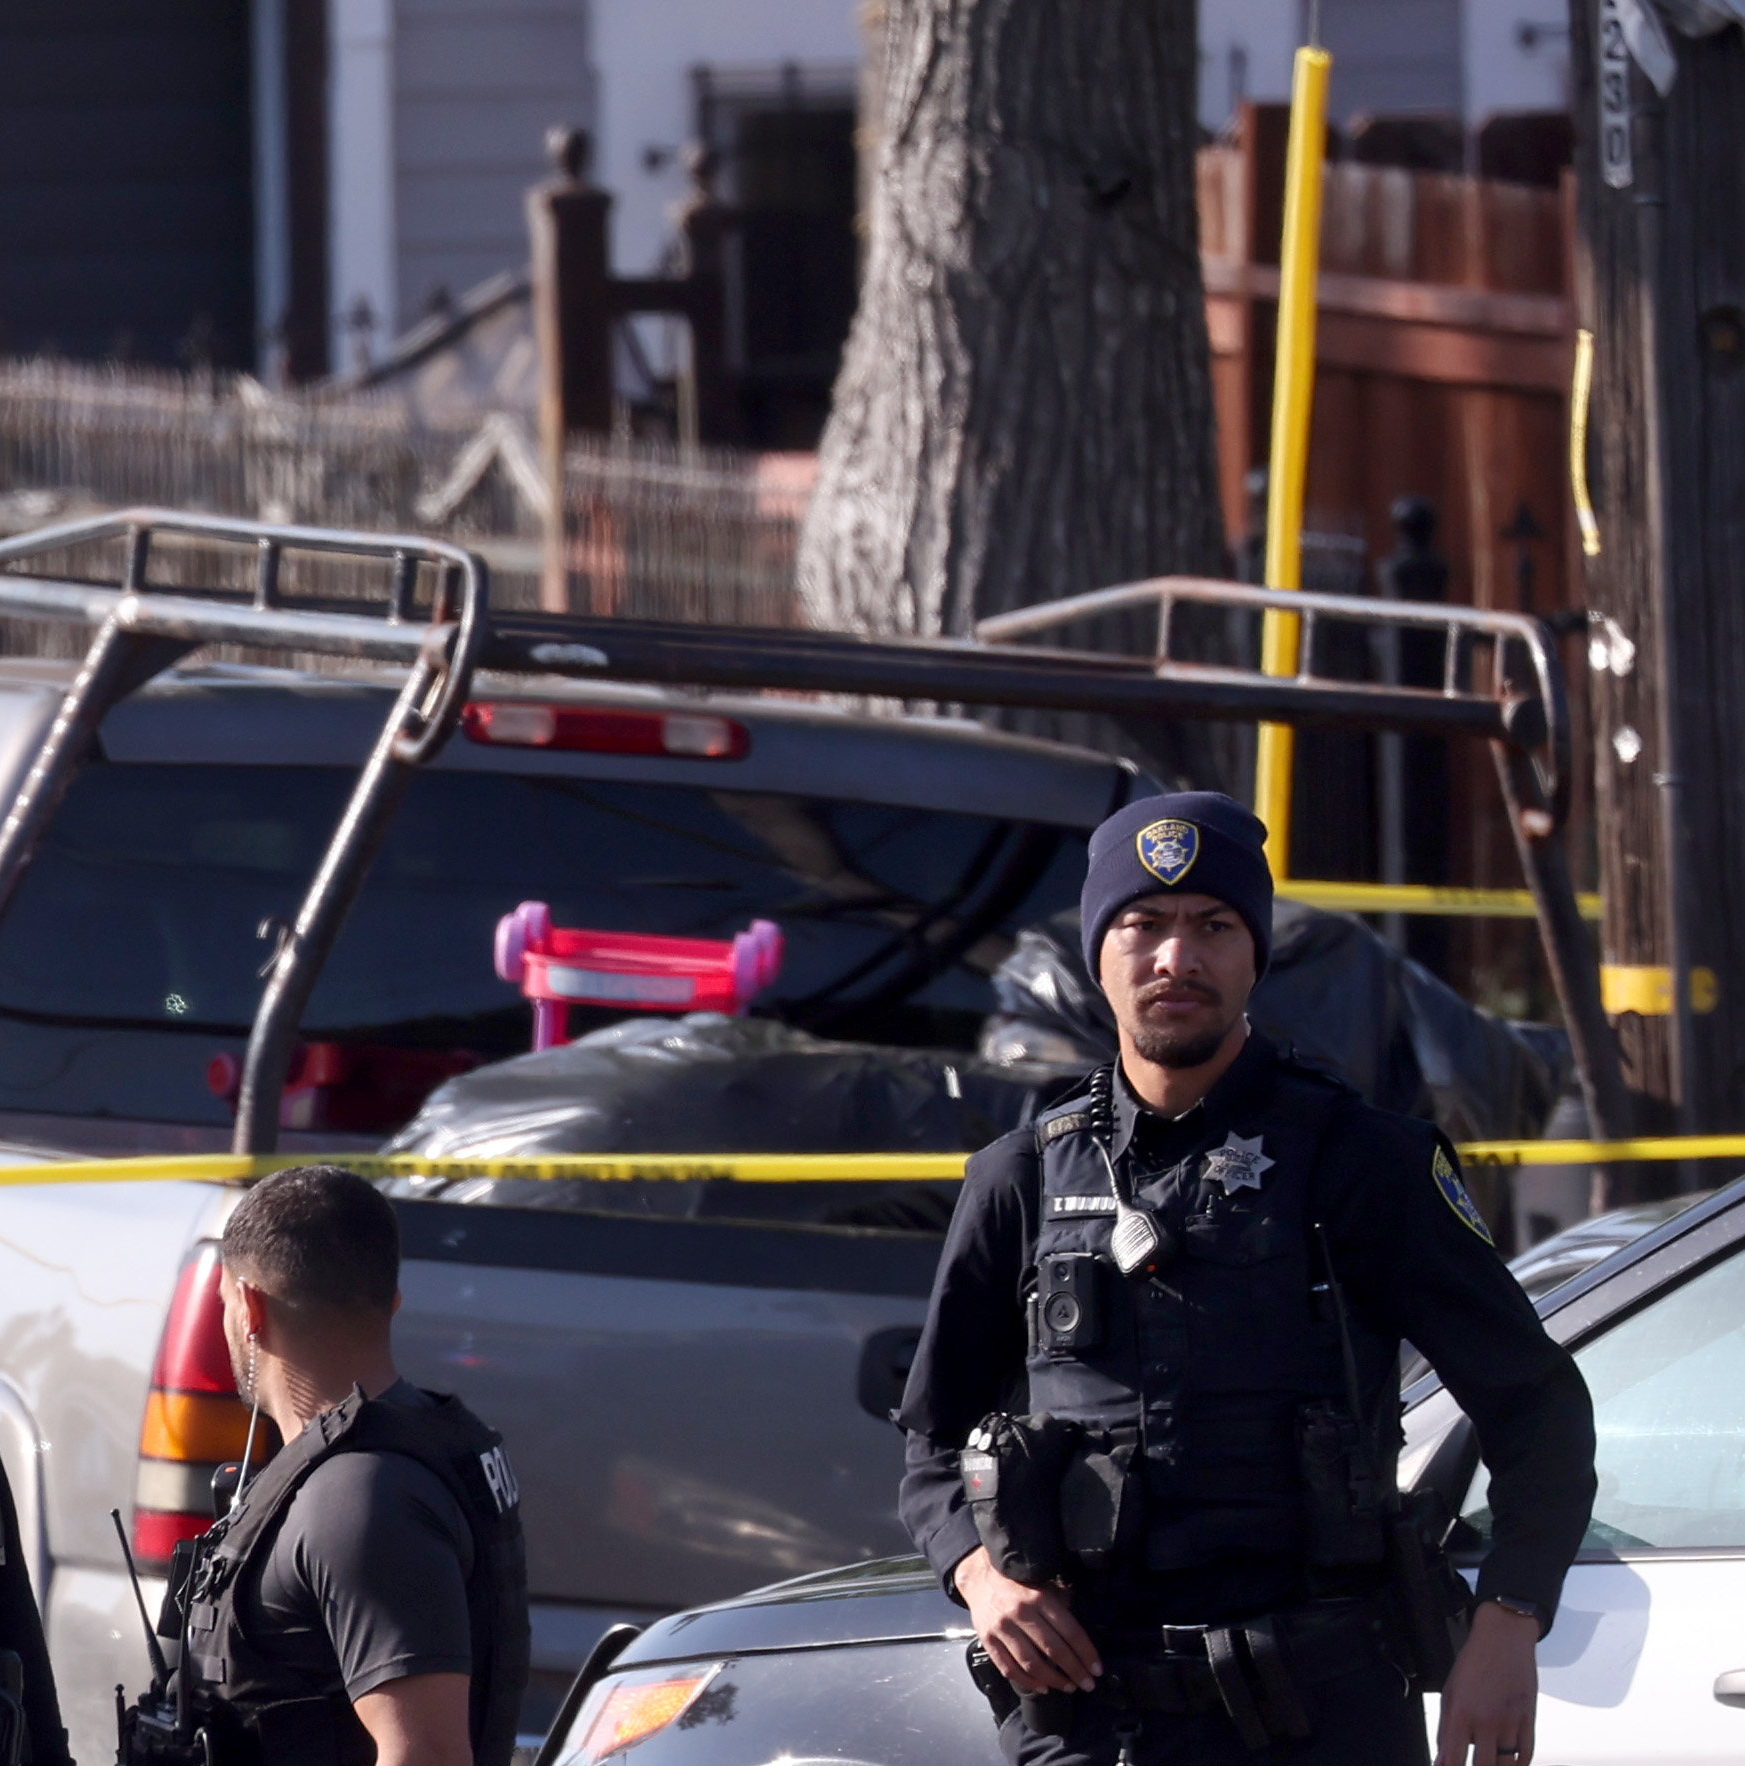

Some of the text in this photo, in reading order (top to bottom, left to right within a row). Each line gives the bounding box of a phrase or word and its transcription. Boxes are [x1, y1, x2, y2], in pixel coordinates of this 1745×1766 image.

[1146, 824, 1189, 839] OAKLAND
[1152, 831, 1184, 843] POLICE
[1219, 1149, 1261, 1164] POLICE
